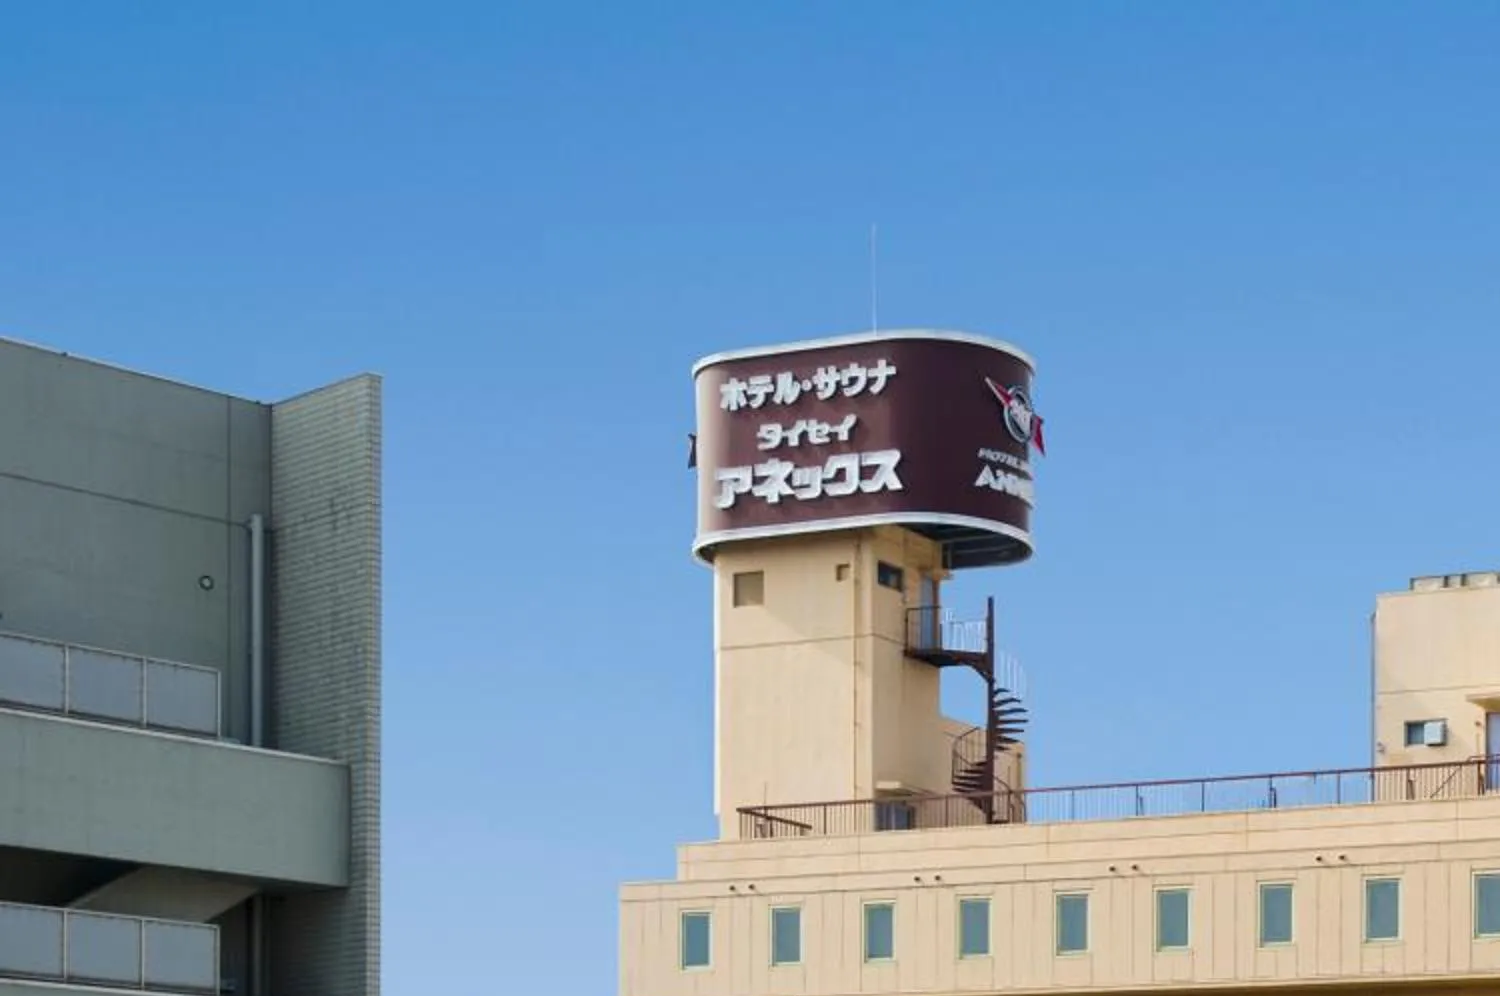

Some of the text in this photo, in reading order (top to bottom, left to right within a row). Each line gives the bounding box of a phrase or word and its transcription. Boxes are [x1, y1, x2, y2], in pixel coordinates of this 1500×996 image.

[719, 359, 897, 411] ホテル・サウナ
[756, 414, 858, 450] タイセイ
[715, 449, 903, 509] アネックス
